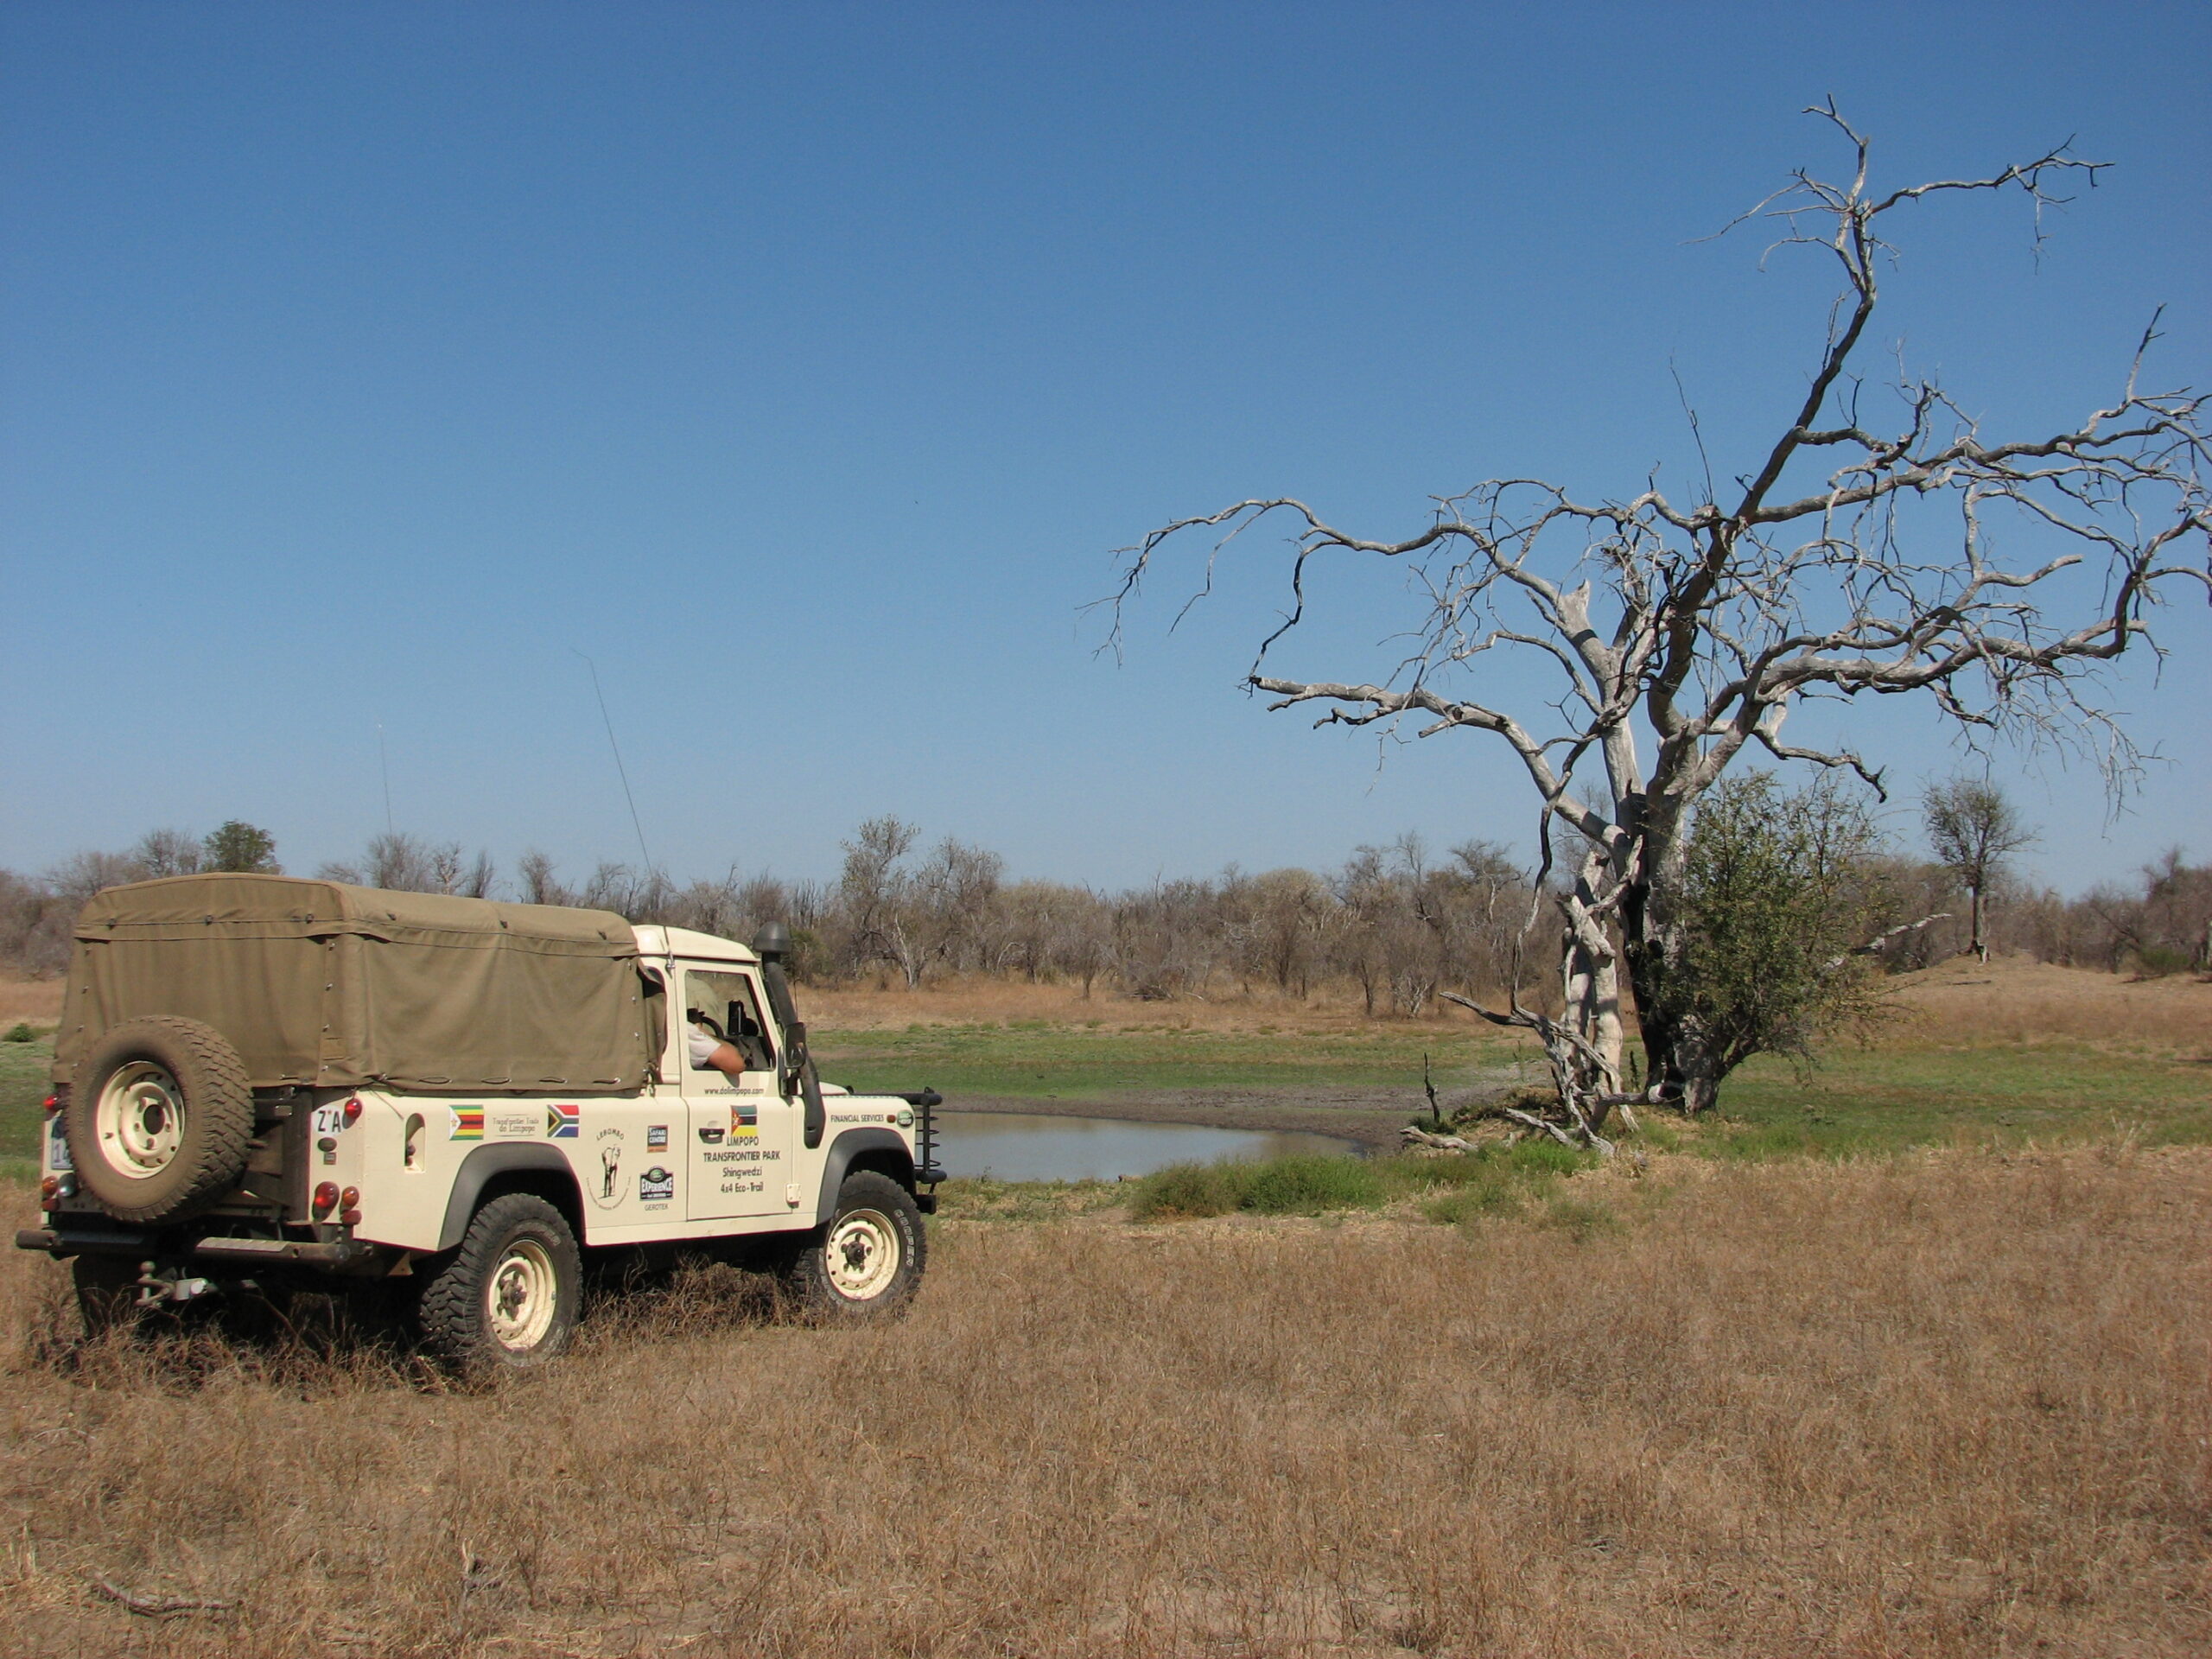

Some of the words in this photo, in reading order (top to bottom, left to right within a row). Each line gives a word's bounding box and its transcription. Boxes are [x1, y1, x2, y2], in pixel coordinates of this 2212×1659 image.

[830, 1114, 859, 1122] FINANCIAL
[861, 1114, 885, 1122] SERVICES
[649, 1127, 666, 1136] SAFARI
[727, 1136, 759, 1146] LIMPOPO
[703, 1151, 760, 1162] TRANSFRONTIER
[762, 1150, 781, 1160] PARK
[722, 1166, 762, 1179] Shingwedzi
[641, 1177, 672, 1193] EXPERIENCE
[721, 1183, 733, 1193] 4x4
[893, 1209, 915, 1267] COOPER
